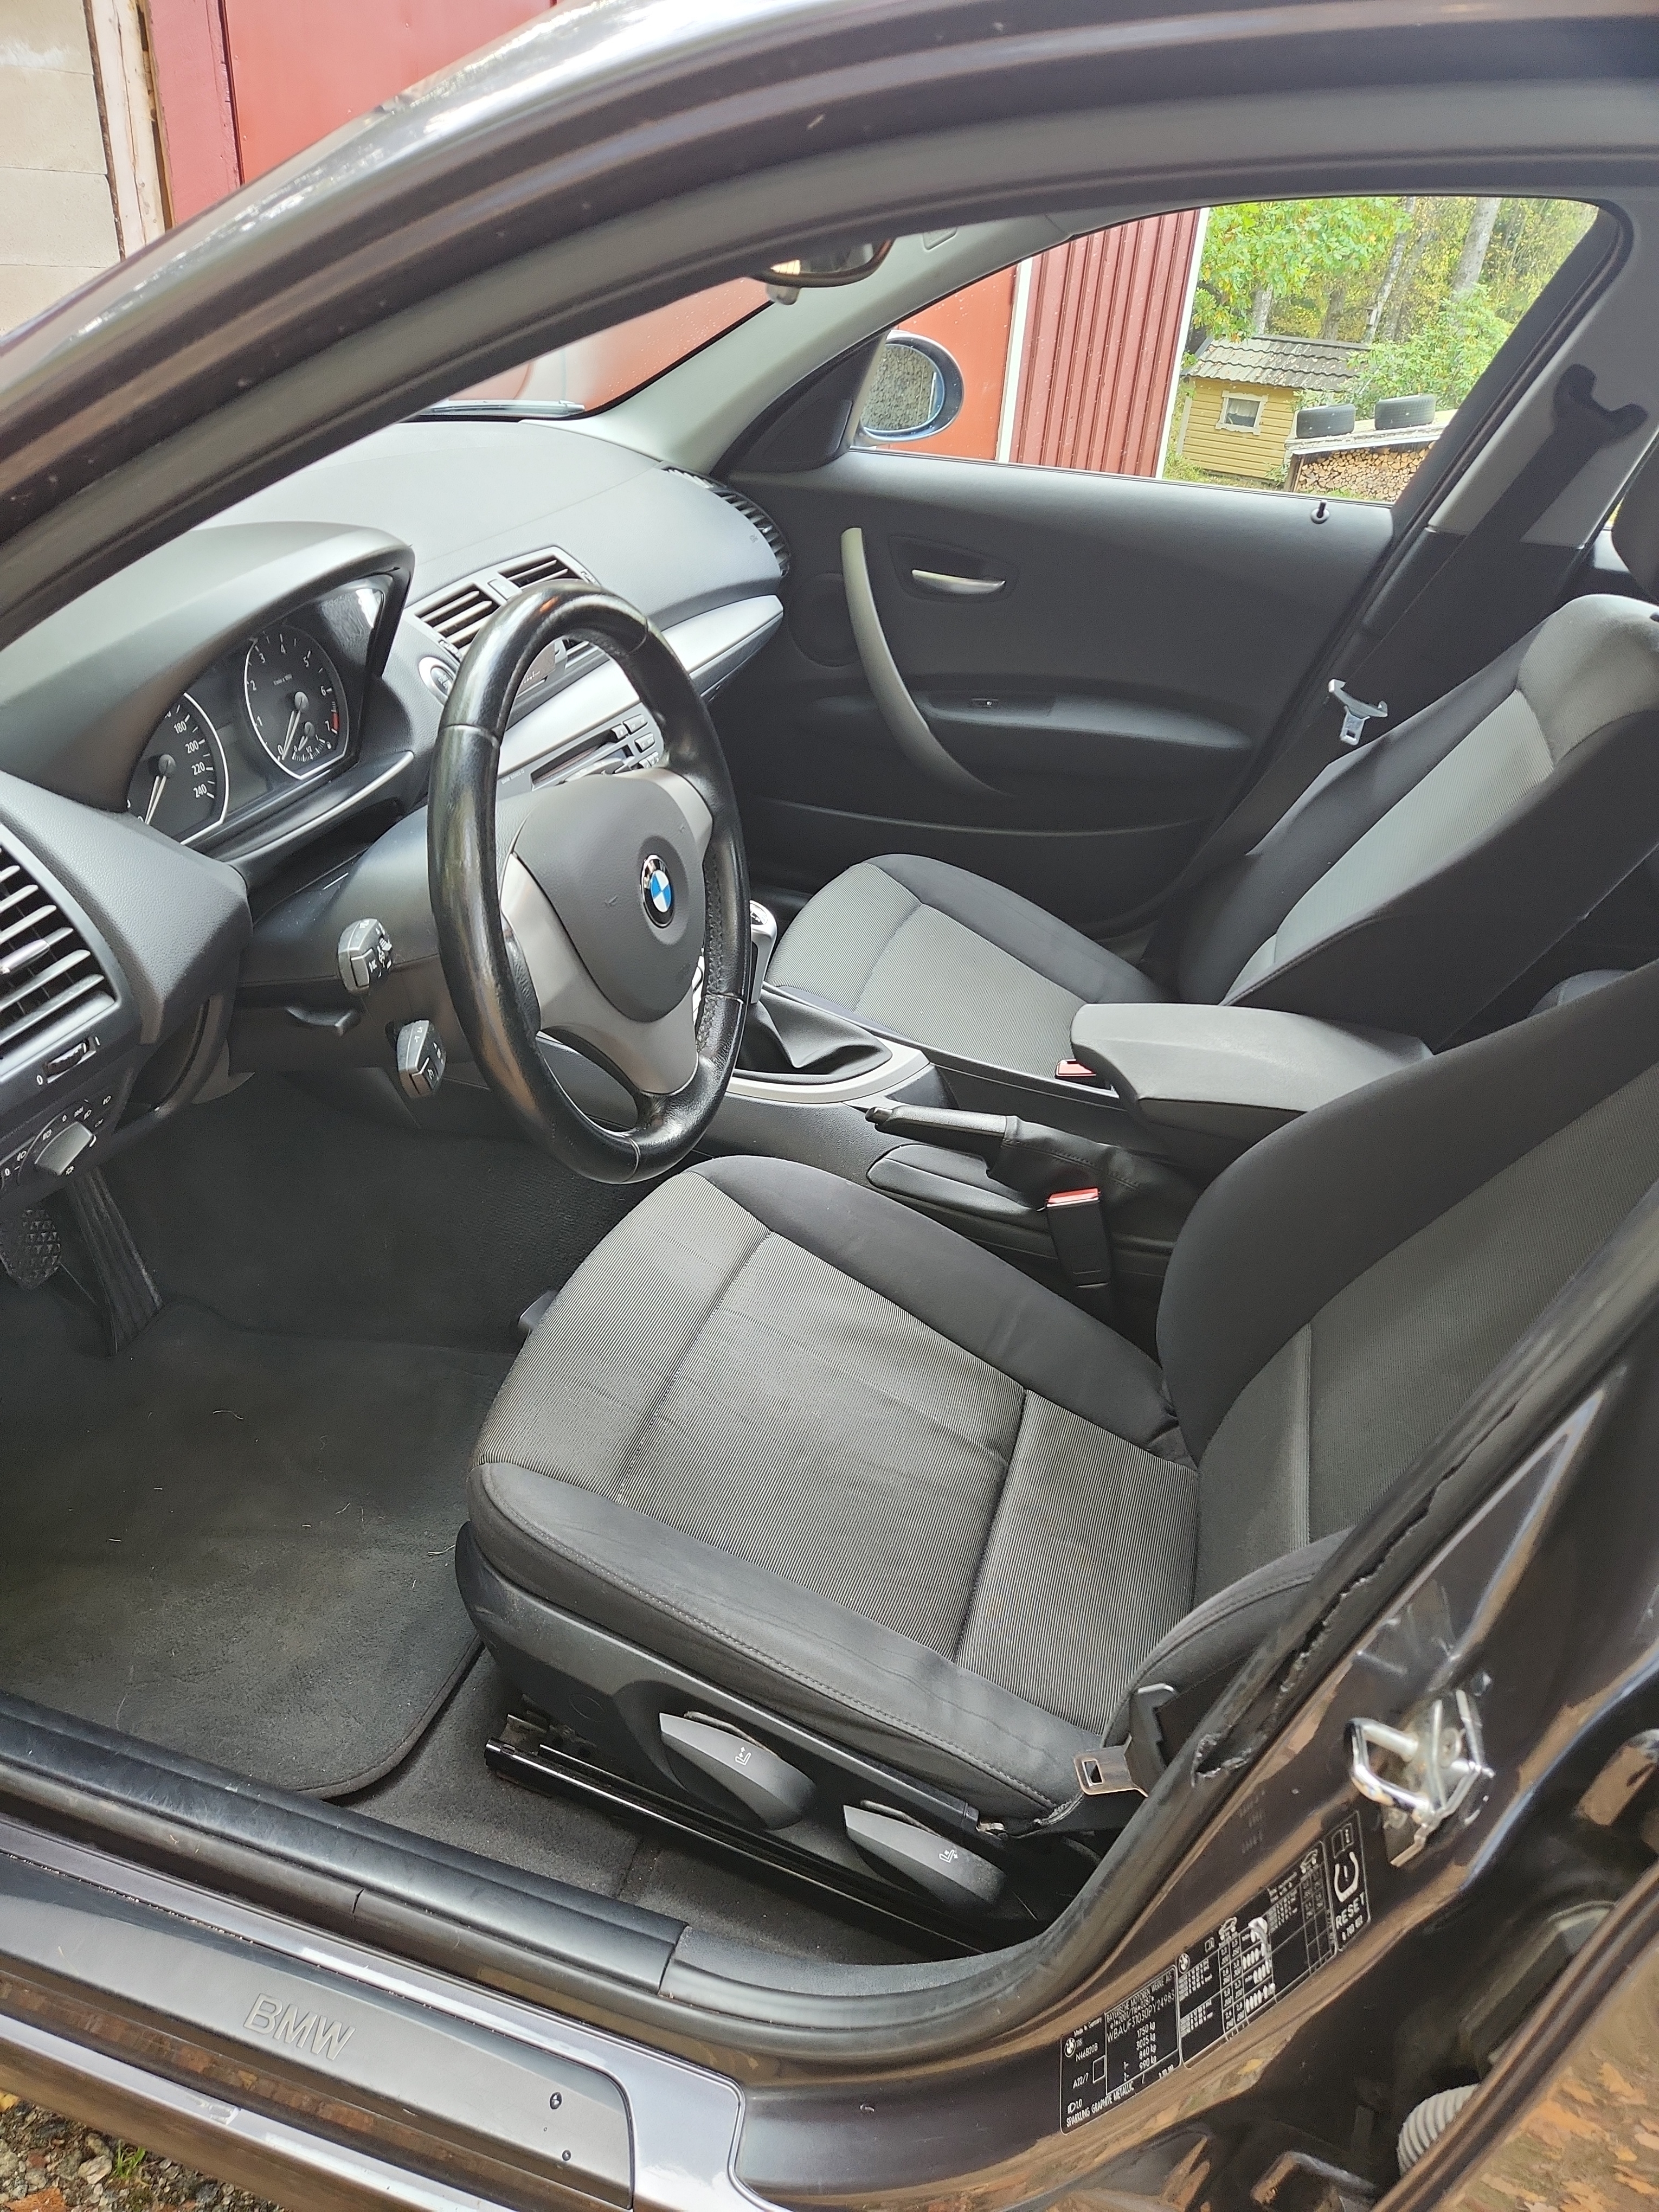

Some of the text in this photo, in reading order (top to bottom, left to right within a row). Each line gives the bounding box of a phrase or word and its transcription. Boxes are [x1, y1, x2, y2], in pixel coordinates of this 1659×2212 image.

[280, 644, 286, 654] 4
[259, 652, 266, 664] 3
[303, 656, 310, 668] 5
[250, 679, 257, 691] 2
[320, 685, 326, 697] 6
[173, 720, 187, 734] 180
[256, 715, 263, 726] 1
[325, 720, 331, 731] 7
[185, 740, 199, 754] 200
[277, 744, 284, 756] 0
[191, 761, 205, 776] 220
[193, 783, 207, 799] 240
[1335, 1892, 1366, 1930] RESET
[243, 1992, 357, 2061] BMW
[1136, 2035, 1149, 2050] 3025
[1139, 2047, 1150, 2060] 840
[1139, 2059, 1150, 2072] 990
[1066, 2106, 1090, 2127] SPARKLING
[1091, 2094, 1113, 2114] GRAPHITE
[1113, 2080, 1135, 2101] METALLIC
